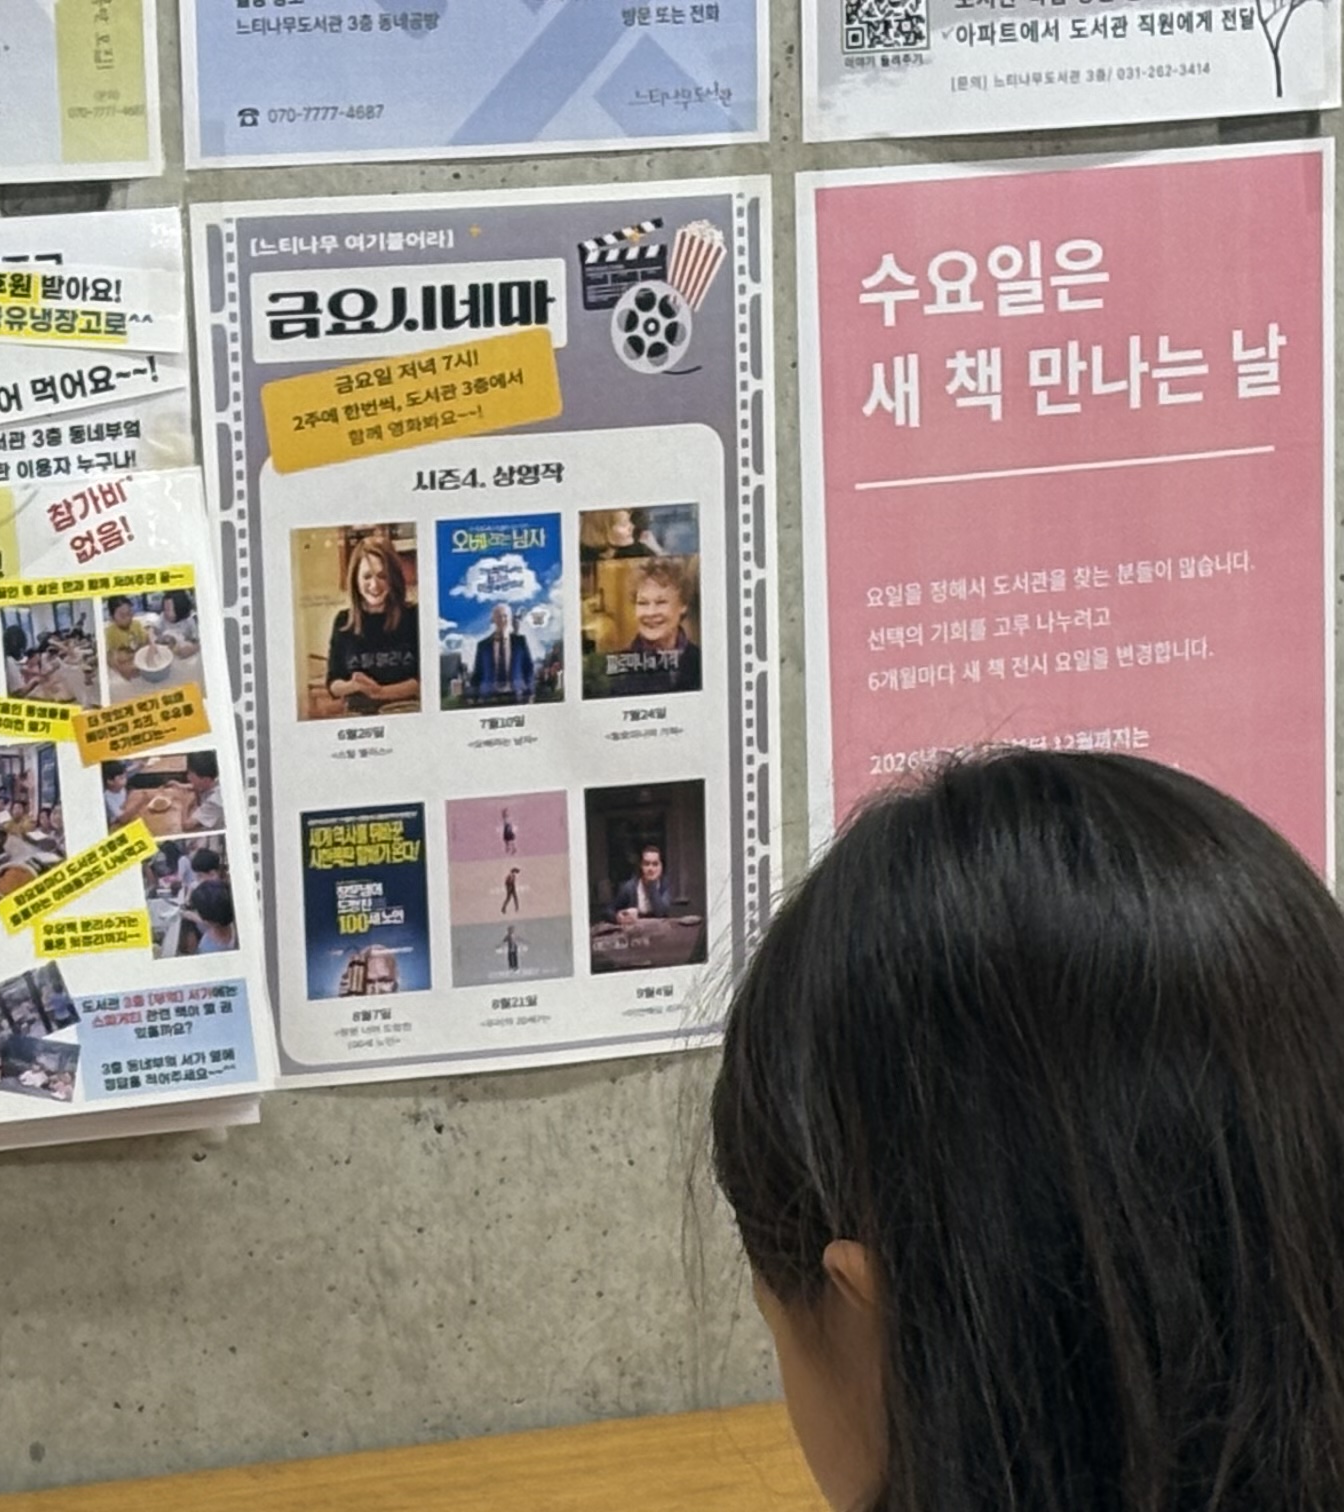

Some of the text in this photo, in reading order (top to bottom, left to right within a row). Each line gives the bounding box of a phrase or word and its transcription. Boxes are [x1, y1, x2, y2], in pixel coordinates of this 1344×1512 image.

[236, 12, 441, 36] 느티나무도서관 3층 동네공방
[656, 6, 686, 26] 또는
[690, 4, 720, 25] 전화
[955, 6, 1256, 48] 아파트에서 도서관 직원에게 전달
[267, 104, 385, 125] 070-7777-4687
[249, 236, 340, 258] [느티나무
[40, 274, 123, 303] 받아요!
[858, 238, 1110, 328] 수요일은
[265, 279, 557, 341] 금요시네마
[333, 349, 480, 395] 금요일 저녁 7시!
[861, 321, 1288, 429] 새 책 만나는 날
[292, 368, 525, 432] 2주에 도서관 3층에서
[32, 427, 63, 450] 3층
[16, 454, 72, 480] 이용자
[75, 449, 138, 473] 누구나!
[413, 462, 566, 492] 시즌4. 상영작
[46, 481, 130, 533] 참가비
[68, 515, 136, 565] 없음!
[866, 582, 923, 610] 요일을
[929, 576, 988, 605] 정해서
[992, 567, 1067, 598] 도서관을
[1073, 562, 1111, 590] 찾는
[1117, 556, 1173, 586] 분들이
[866, 622, 924, 652] 선택의
[992, 613, 1031, 638] 고루
[1036, 607, 1112, 635] 나누려고
[867, 635, 1216, 693] 6개월마다 새 책 전시 요일을 변경합니다.
